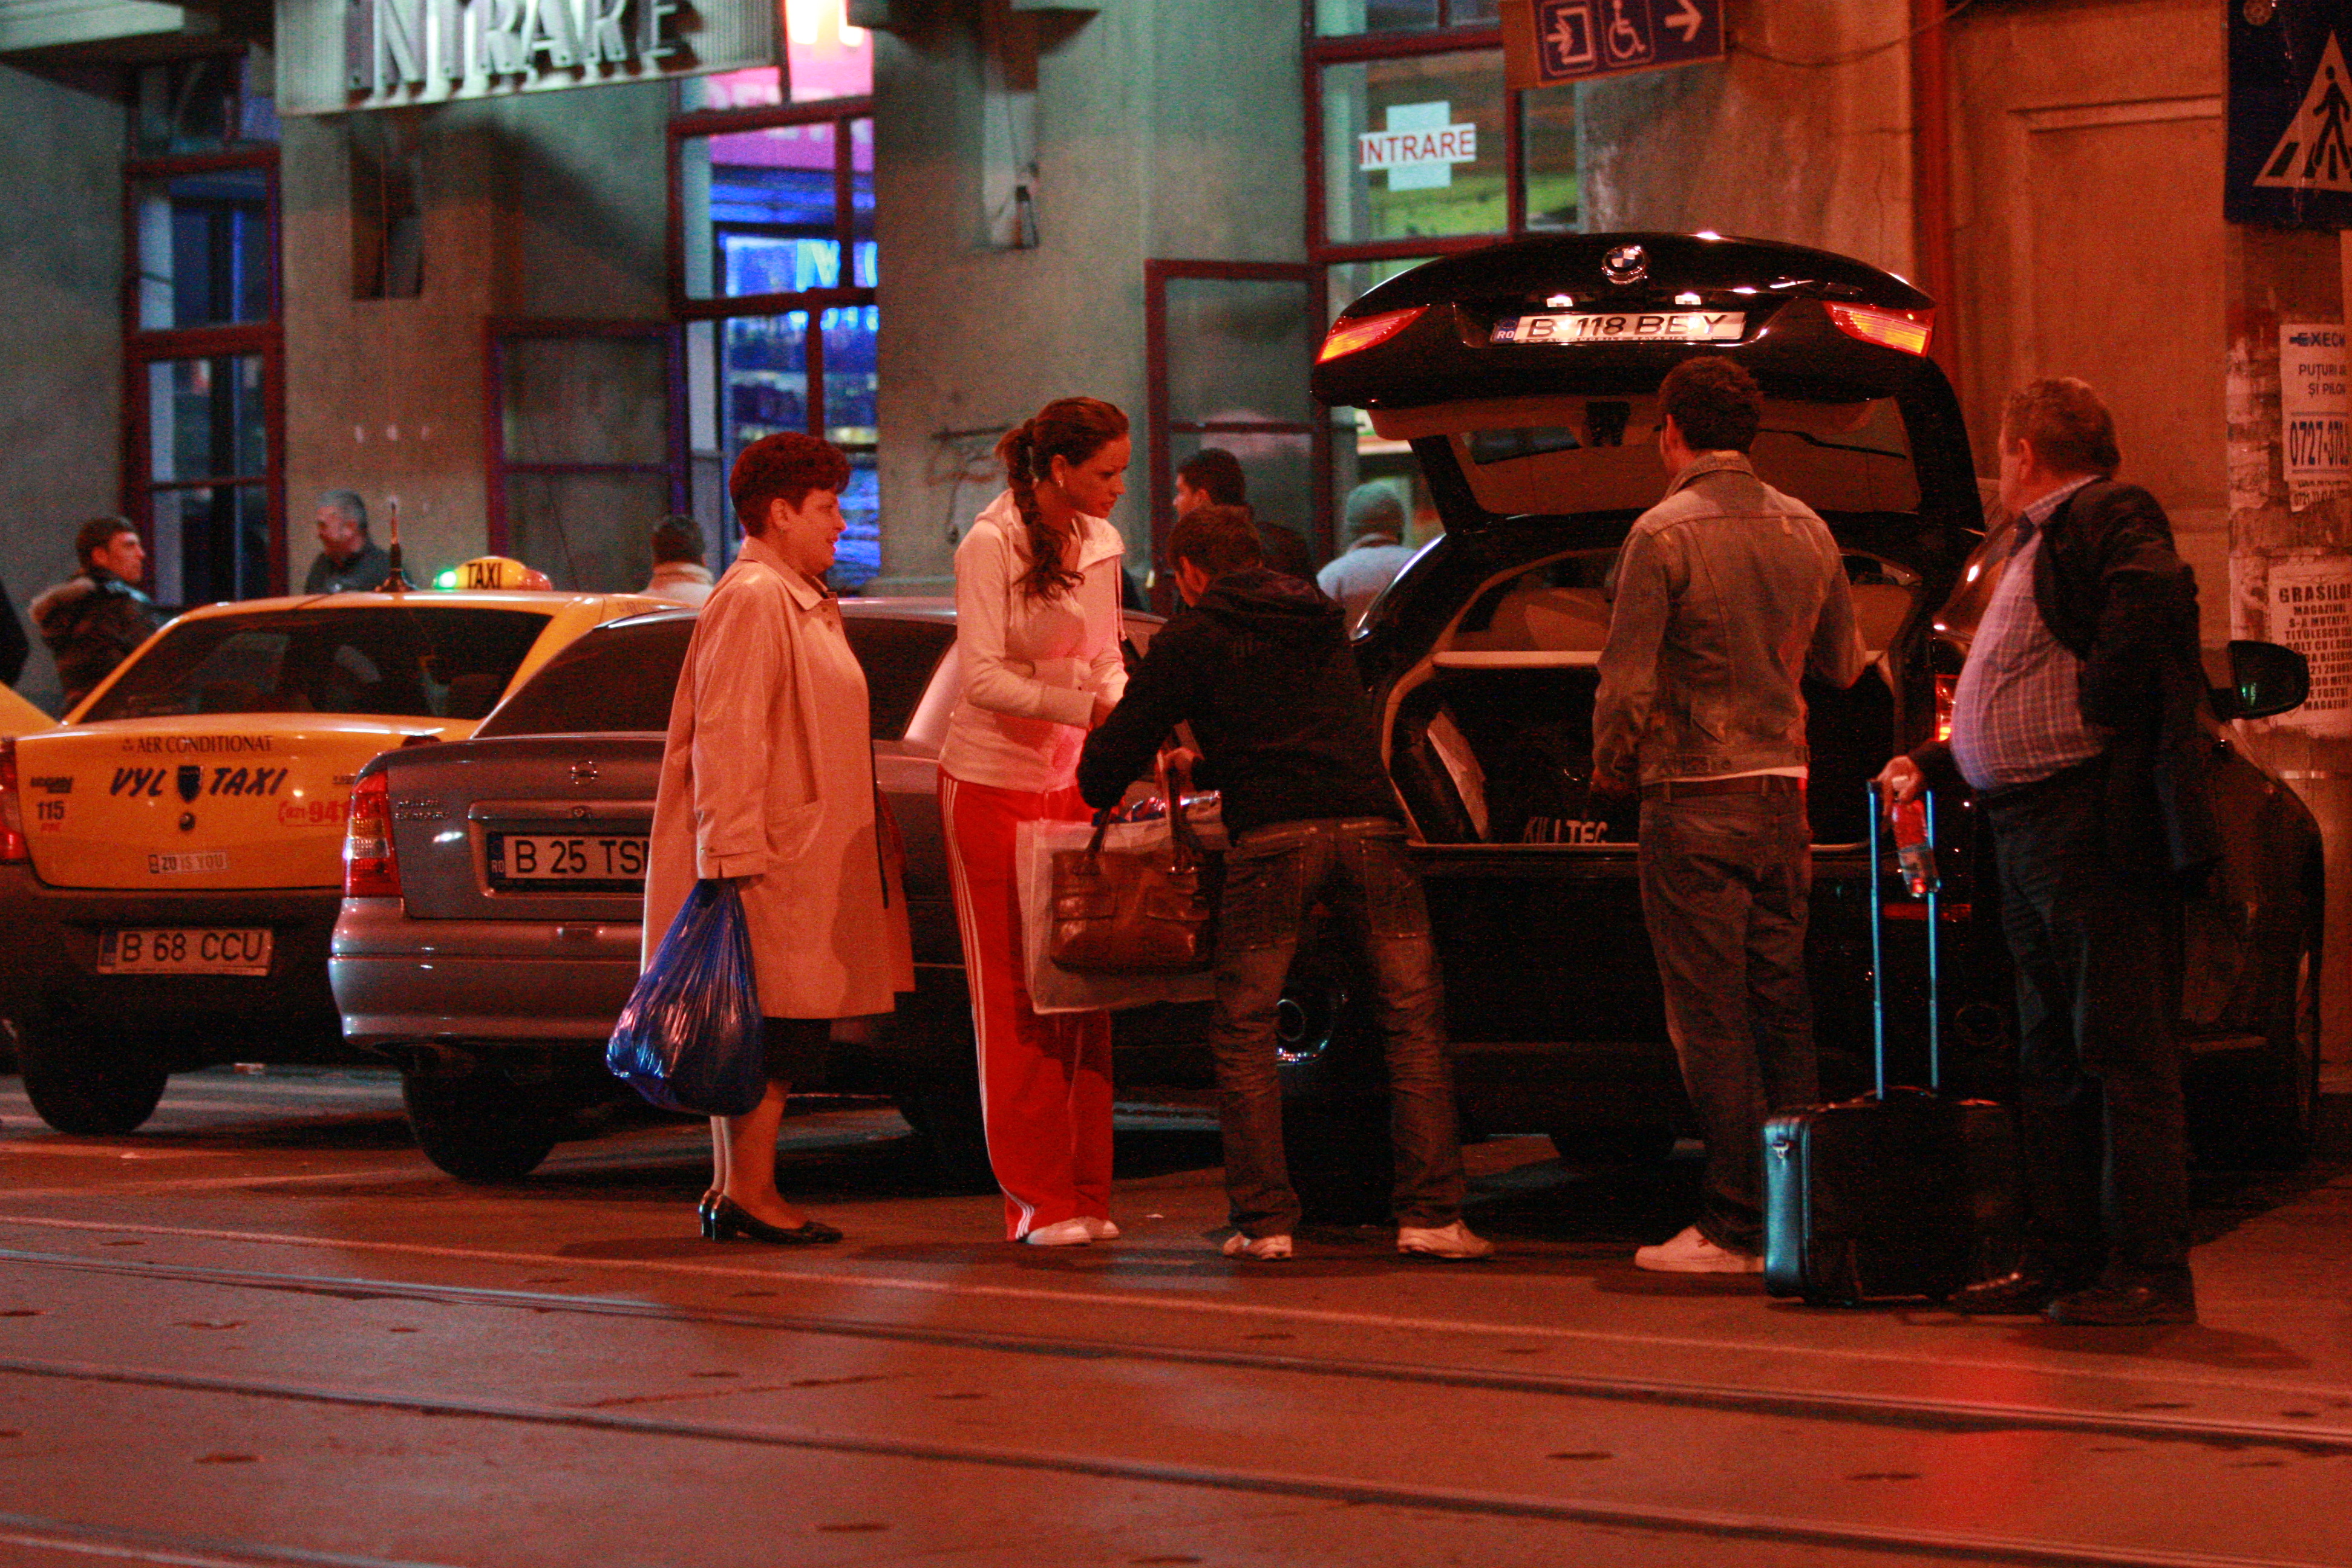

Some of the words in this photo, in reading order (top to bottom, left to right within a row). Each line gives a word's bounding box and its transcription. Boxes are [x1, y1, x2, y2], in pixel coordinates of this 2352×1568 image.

[1359, 129, 1476, 165] INTRARE
[1497, 331, 1514, 340] RO
[1526, 318, 1555, 338] B
[1576, 316, 1627, 337] 118
[466, 562, 503, 589] TAXI
[137, 737, 163, 753] AER
[166, 735, 273, 753] CONDITIONAT
[108, 767, 167, 797] VYL
[208, 766, 289, 796] TAXI
[36, 800, 65, 821] 115
[491, 860, 505, 874] RO
[515, 840, 537, 874] B
[550, 840, 587, 874] 25
[599, 839, 649, 875] TS
[122, 932, 142, 962] B
[153, 932, 187, 962] 68
[201, 932, 264, 962] CCU
